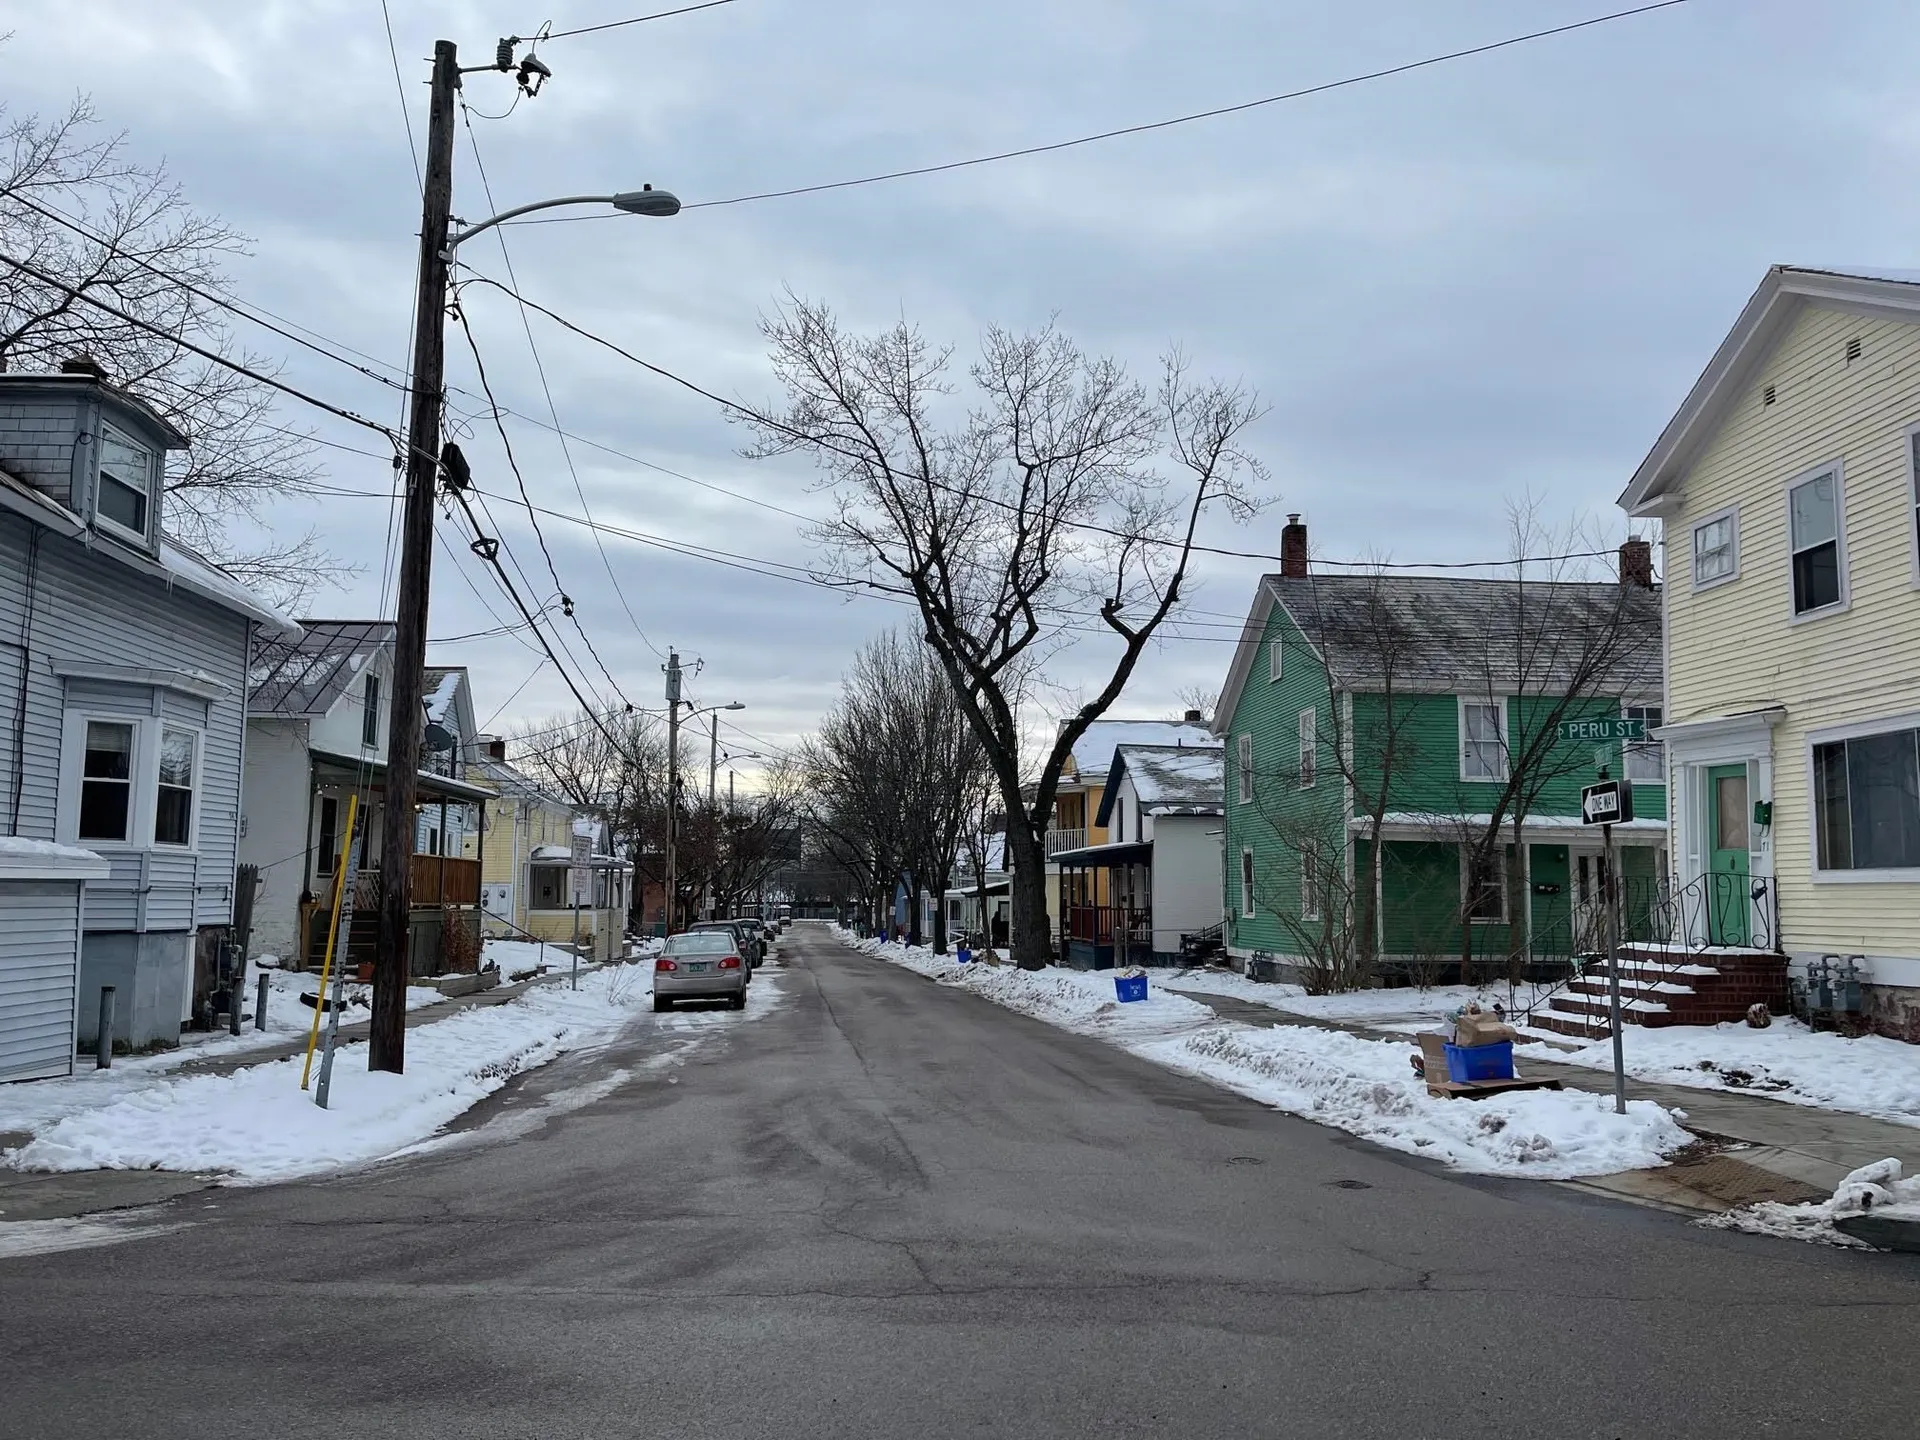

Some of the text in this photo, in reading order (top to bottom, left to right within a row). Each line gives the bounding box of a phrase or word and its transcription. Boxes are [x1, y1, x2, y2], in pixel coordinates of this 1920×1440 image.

[1568, 722, 1609, 738] PERU
[1592, 793, 1616, 812] ONE WAY
